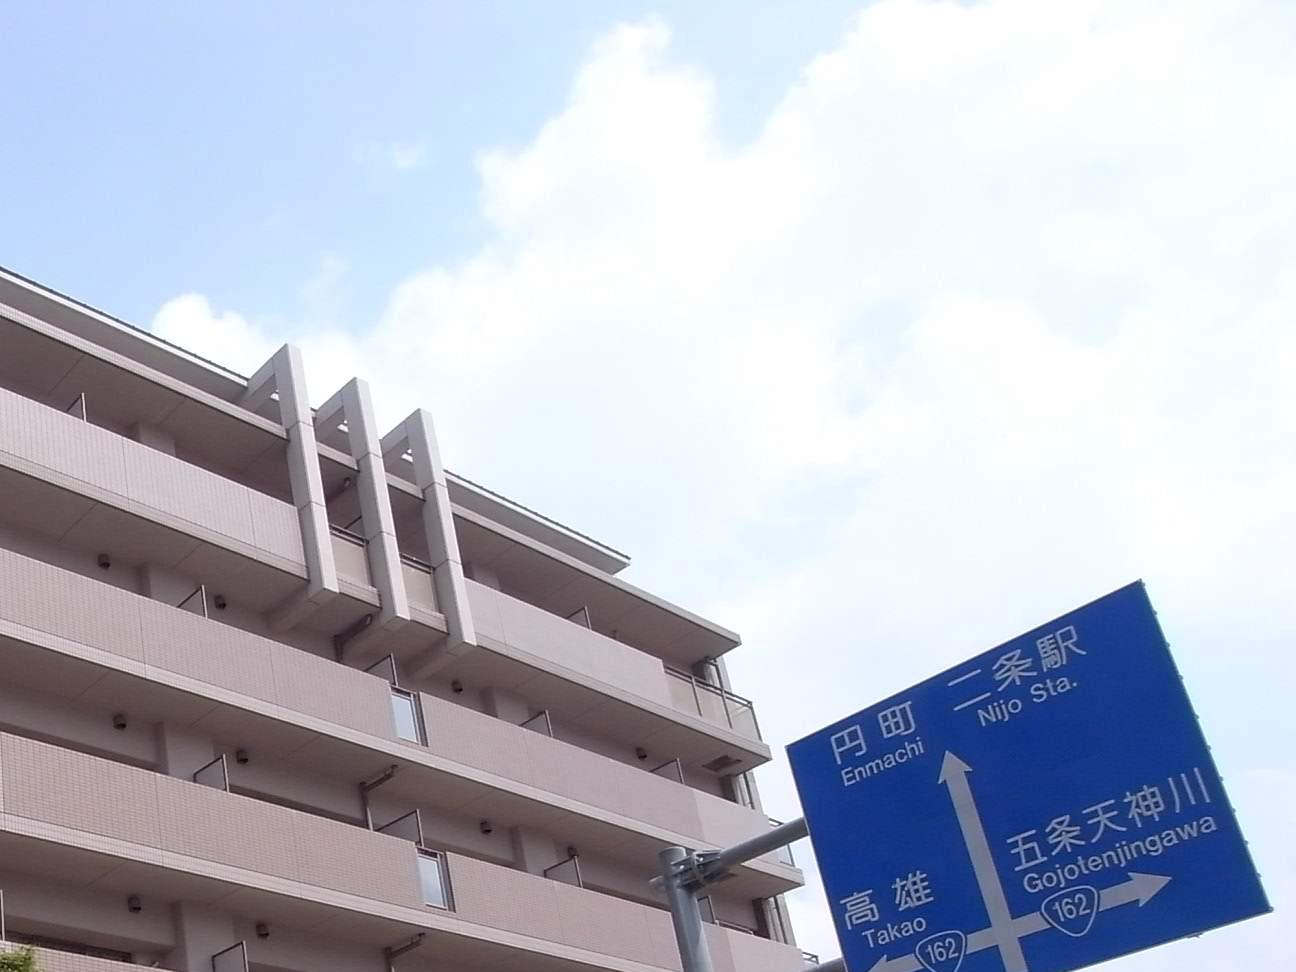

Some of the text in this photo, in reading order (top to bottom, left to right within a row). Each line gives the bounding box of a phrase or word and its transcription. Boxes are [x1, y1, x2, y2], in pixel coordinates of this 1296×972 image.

[947, 625, 1087, 711] 二条駅
[977, 677, 1078, 727] Nijo Sta.
[831, 701, 916, 764] 円町
[841, 736, 925, 787] Enmachi
[1006, 767, 1211, 871] 五条天神川
[1023, 816, 1217, 893] Gojotenjingawa
[840, 870, 934, 930] 高雄
[1053, 893, 1091, 922] 162
[862, 917, 927, 948] Takao
[925, 938, 959, 964] 162
